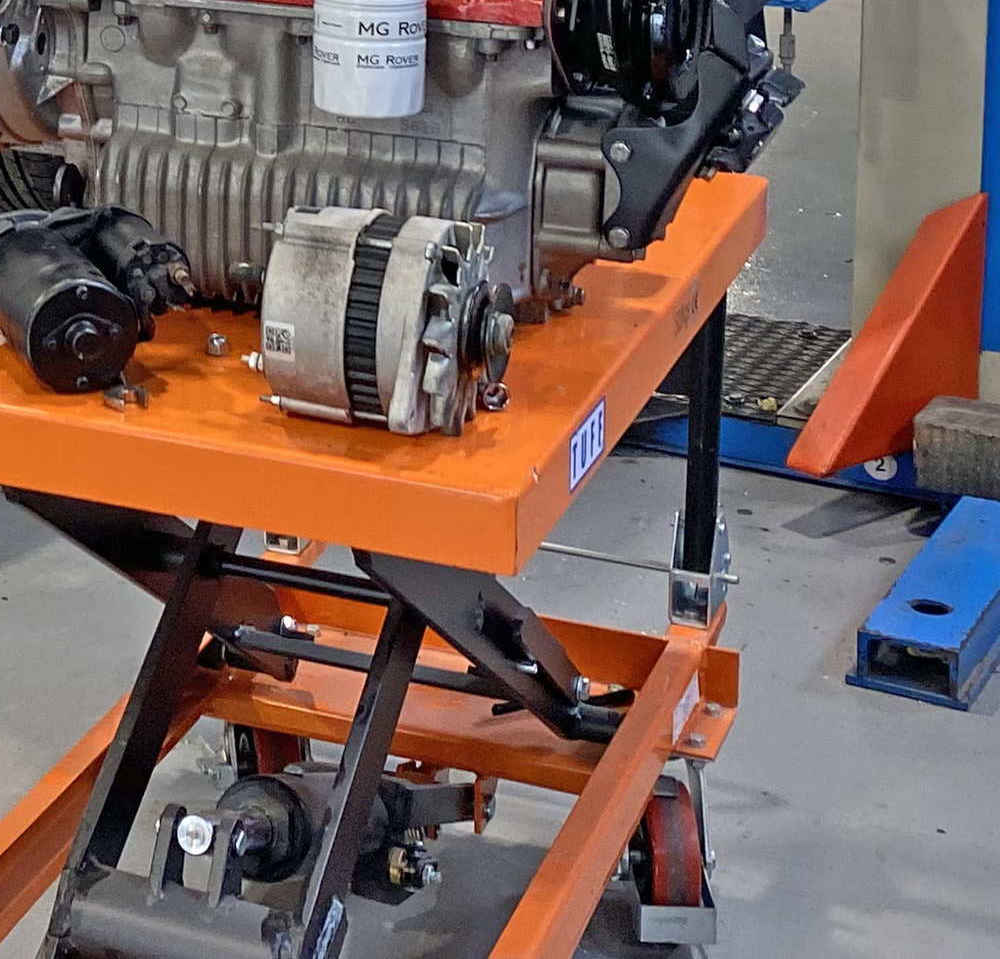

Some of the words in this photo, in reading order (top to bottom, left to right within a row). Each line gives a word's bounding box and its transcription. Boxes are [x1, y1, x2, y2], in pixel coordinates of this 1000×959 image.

[358, 21, 390, 36] MG
[357, 54, 380, 65] MG
[386, 54, 419, 65] ROVER
[572, 409, 603, 481] TUFF
[875, 458, 886, 472] 2
